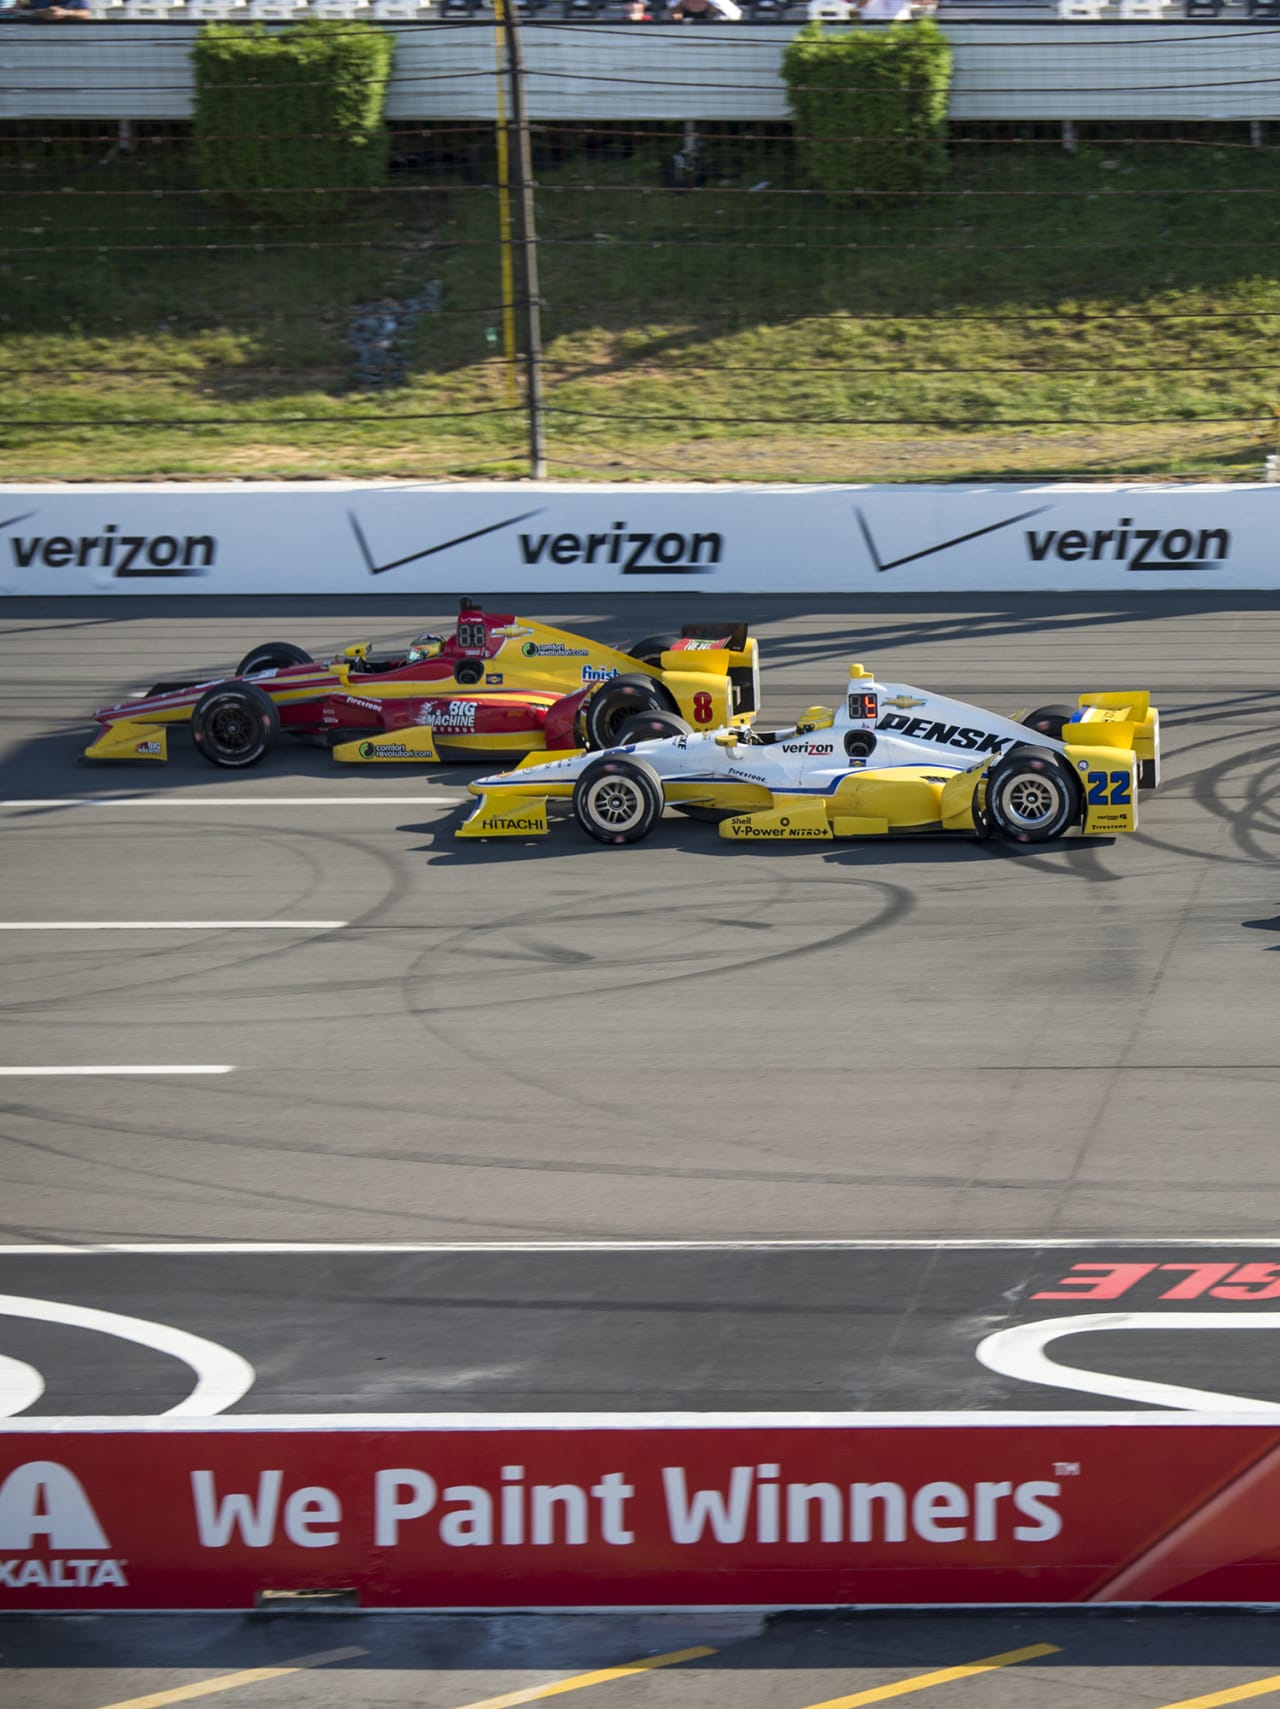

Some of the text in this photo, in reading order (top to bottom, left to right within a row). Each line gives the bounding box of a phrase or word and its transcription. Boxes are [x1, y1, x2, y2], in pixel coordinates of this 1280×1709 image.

[10, 524, 217, 577] verizon
[519, 521, 725, 574] verizon
[1024, 518, 1231, 571] verizon
[450, 701, 477, 715] BIG
[693, 691, 713, 724] 8
[426, 714, 475, 727] MACHINE
[375, 750, 432, 758] revolution.com
[782, 742, 833, 755] verizon
[728, 767, 766, 783] Firestone
[1088, 771, 1131, 805] 22
[482, 818, 543, 831] HITACHI
[731, 817, 752, 825] Shell
[732, 826, 786, 836] V-Power
[190, 1469, 342, 1548] We
[374, 1465, 635, 1547] Paint
[661, 1463, 1063, 1544] Winners
